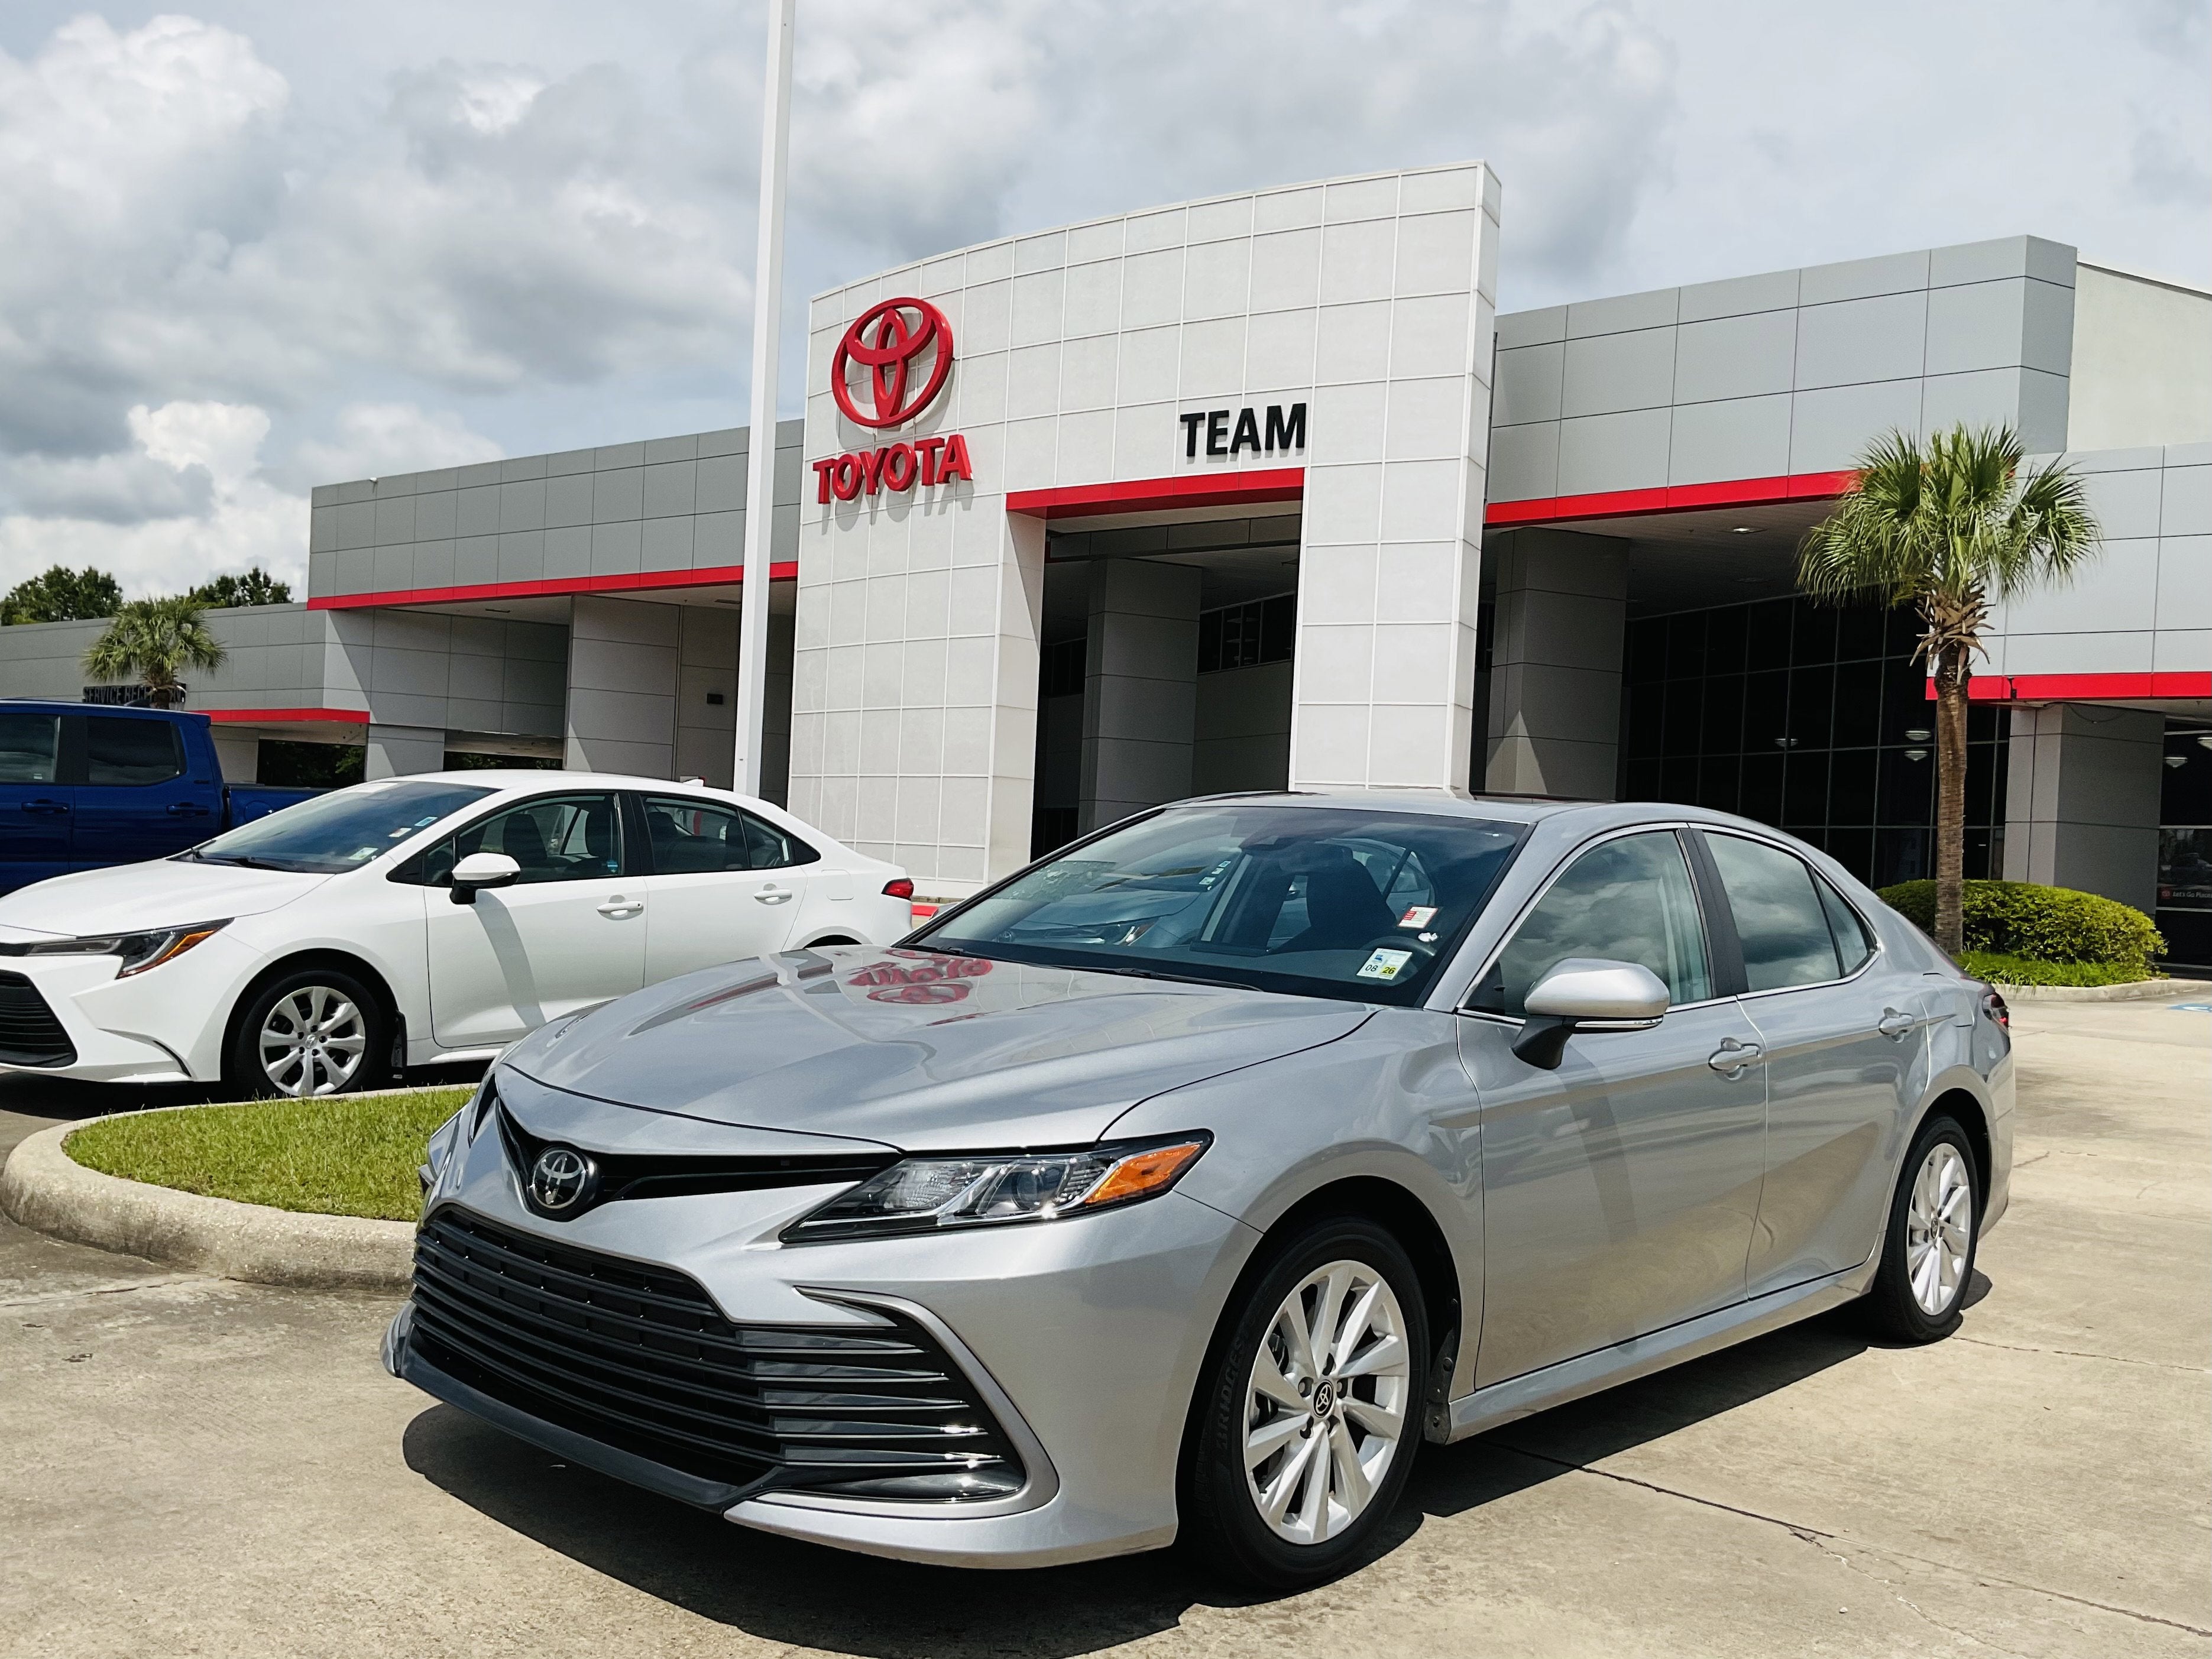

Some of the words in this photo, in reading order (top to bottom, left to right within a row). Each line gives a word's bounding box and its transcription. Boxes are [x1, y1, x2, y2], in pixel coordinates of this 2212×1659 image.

[1180, 403, 1306, 456] TEAM
[813, 435, 973, 504] TOYOTA
[83, 685, 122, 704] SERVICE
